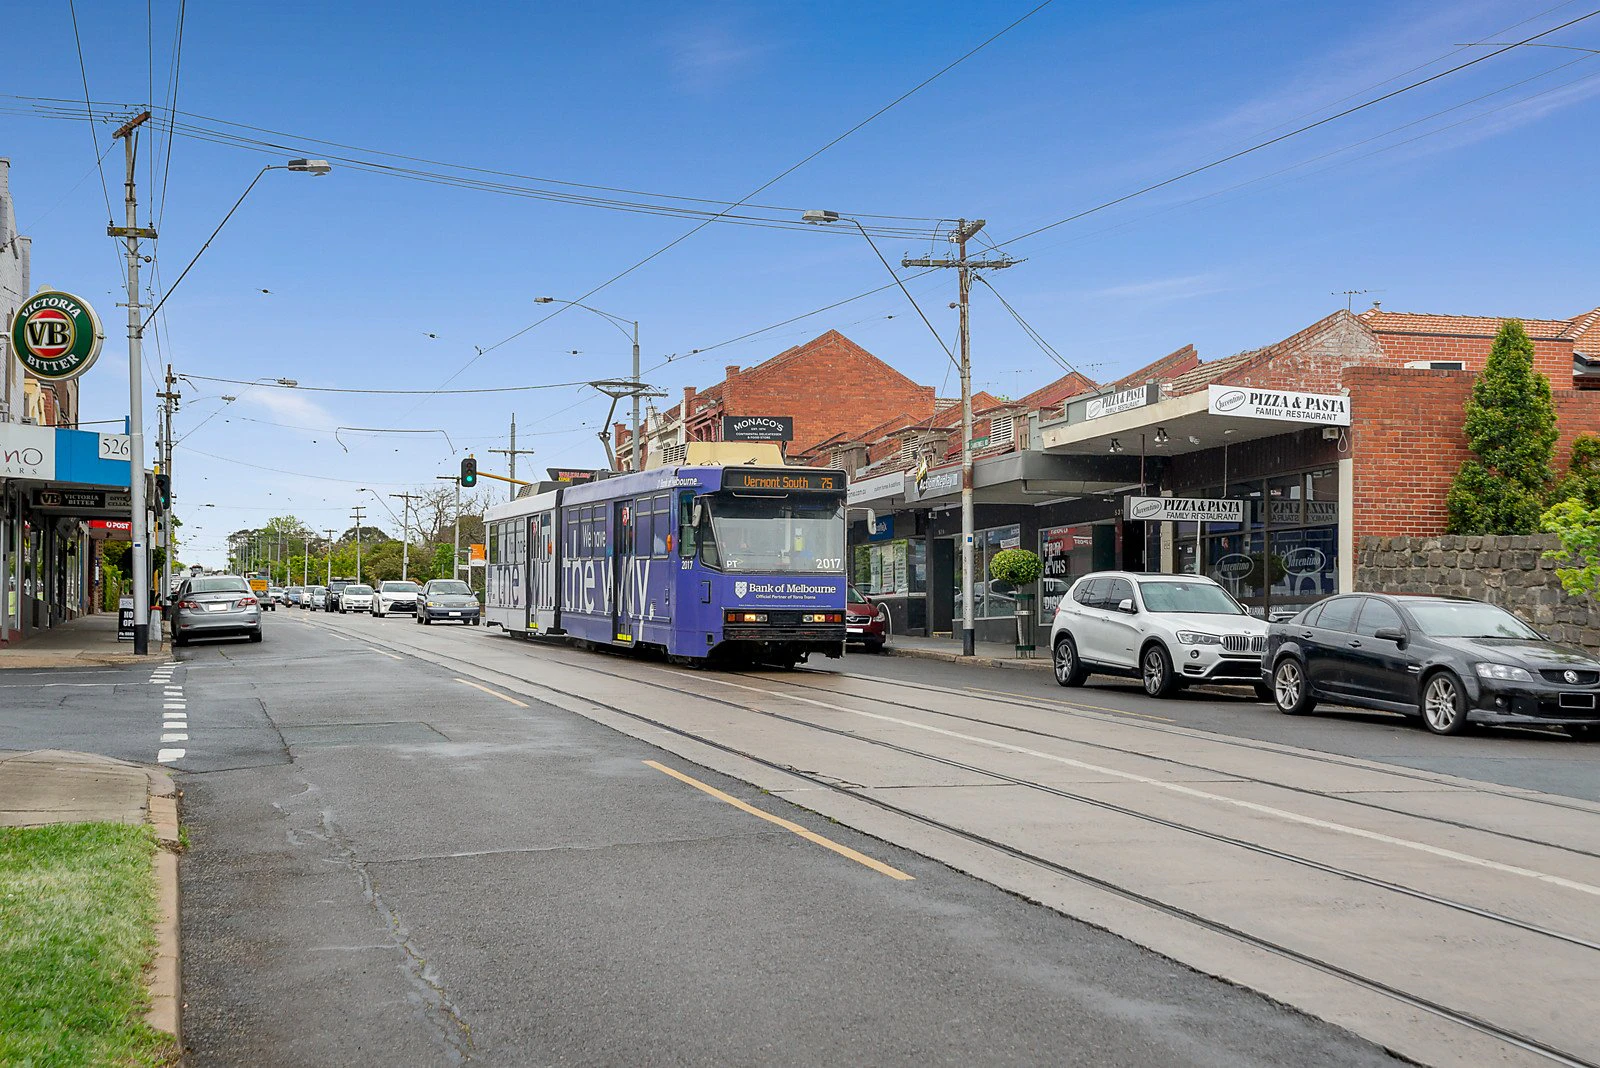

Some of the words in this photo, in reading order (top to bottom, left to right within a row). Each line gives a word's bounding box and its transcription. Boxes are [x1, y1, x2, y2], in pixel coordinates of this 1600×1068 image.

[22, 298, 81, 318] VICTORIA
[28, 321, 70, 346] VB
[27, 354, 79, 371] BITTER
[1102, 393, 1120, 409] PIZZA
[1119, 393, 1125, 403] &
[1126, 387, 1145, 402] PASTA
[1249, 392, 1289, 407] PIZZA
[1292, 397, 1302, 408] &
[1305, 397, 1345, 413] PASTA
[1105, 406, 1117, 414] FAMILY
[1255, 407, 1283, 417] FAMILY
[1286, 410, 1337, 421] RESTAURANT
[734, 418, 784, 432] MONACO'S
[102, 438, 129, 456] 526
[5, 467, 38, 475] ARS
[743, 475, 780, 488] Vermont
[782, 476, 809, 489] South
[821, 477, 833, 489] 75
[1163, 499, 1196, 511] PIZZA
[1198, 500, 1206, 512] &
[1207, 501, 1240, 513] PASTA
[1166, 511, 1189, 520] FAMILY
[1190, 512, 1238, 521] RESTAURANT
[682, 560, 693, 570] 2017
[727, 560, 738, 568] PT
[816, 558, 841, 569] 2017
[1051, 560, 1066, 575] VHS
[562, 527, 596, 615] the
[749, 583, 773, 593] Bank
[775, 583, 785, 593] of
[786, 583, 836, 594] Melbourne
[1045, 580, 1055, 592] TO
[123, 610, 134, 619] NO
